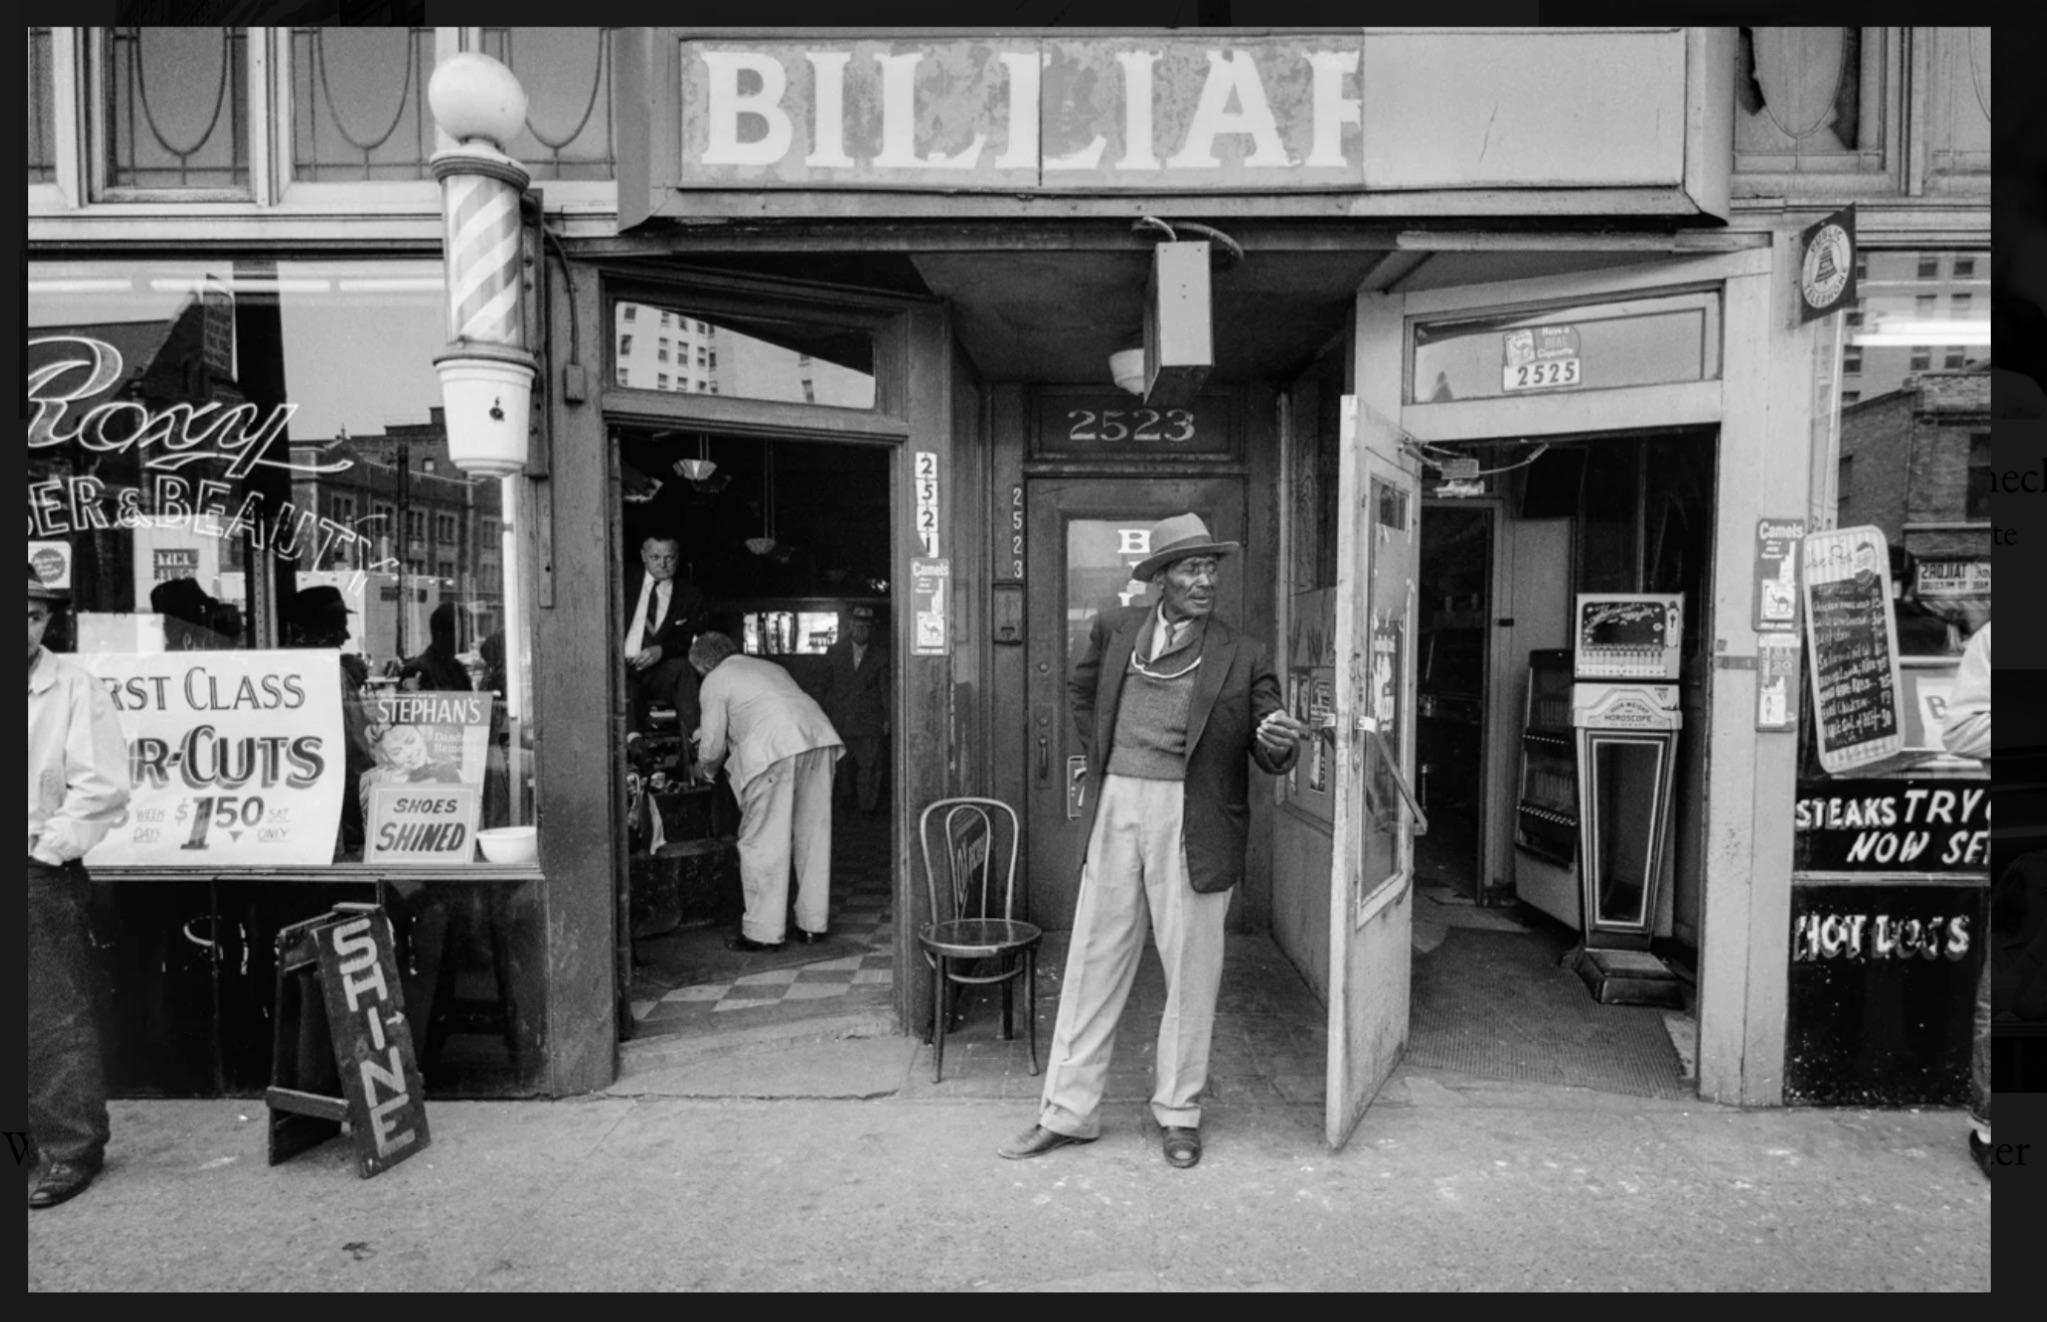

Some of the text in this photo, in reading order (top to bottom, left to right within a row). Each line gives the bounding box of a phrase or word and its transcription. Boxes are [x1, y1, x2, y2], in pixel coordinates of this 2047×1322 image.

[1517, 361, 1575, 387] 2525
[1067, 409, 1195, 441] 2523
[28, 475, 107, 537] ER
[1760, 521, 1804, 540] Camels
[912, 562, 949, 578] Camels
[184, 666, 306, 711] CLASS
[377, 697, 481, 724] STEPHAN'S
[393, 797, 458, 814] SHOES
[1796, 789, 1984, 829] STEAKS TRY
[376, 822, 466, 852] SHINED
[1846, 831, 1991, 865] NOW SE
[332, 917, 417, 1159] SHINE
